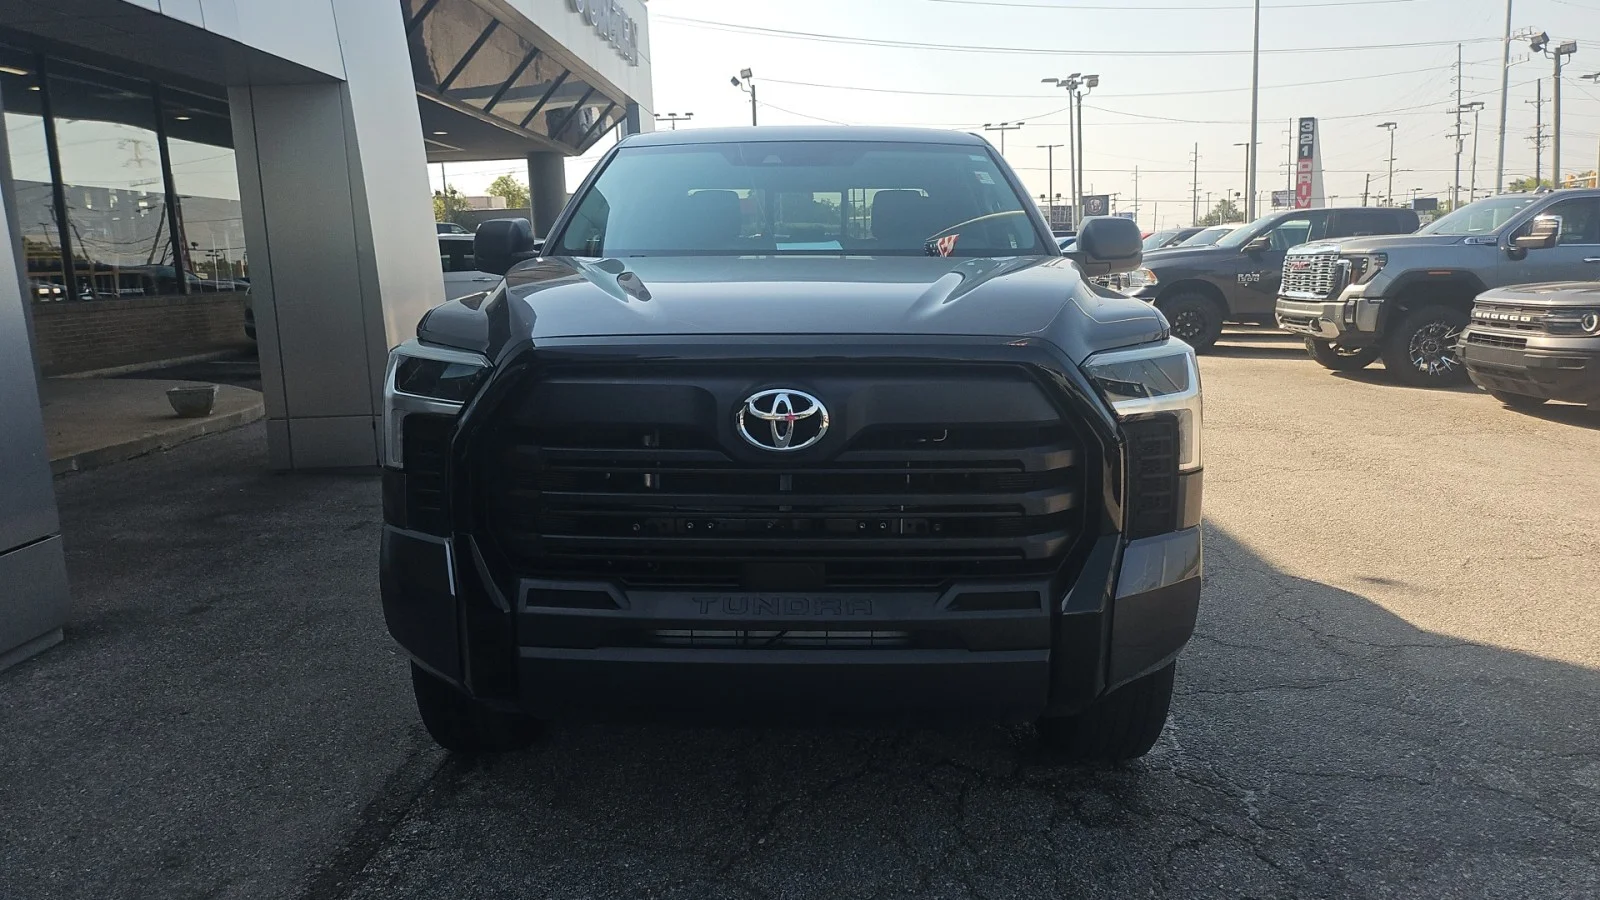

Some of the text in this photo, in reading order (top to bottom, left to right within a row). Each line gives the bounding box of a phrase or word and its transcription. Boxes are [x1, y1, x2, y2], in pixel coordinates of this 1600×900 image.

[1300, 121, 1314, 156] 321
[1475, 312, 1531, 322] BRONCO
[692, 597, 873, 616] TUNDRA
